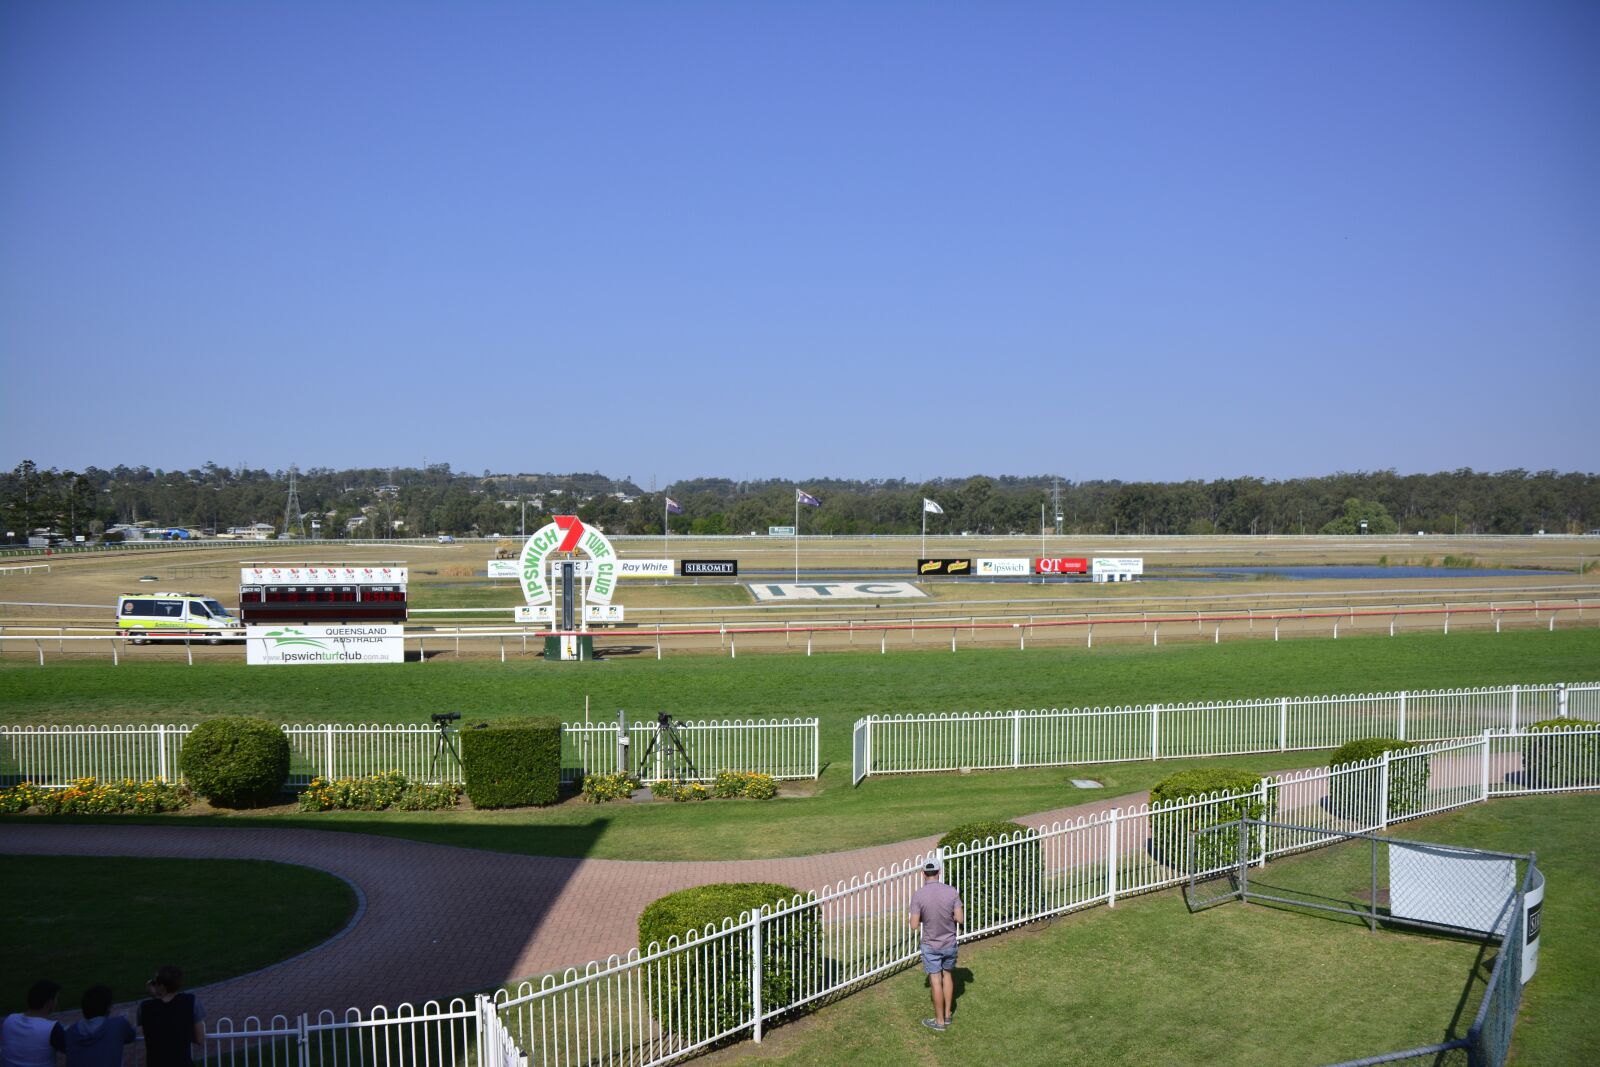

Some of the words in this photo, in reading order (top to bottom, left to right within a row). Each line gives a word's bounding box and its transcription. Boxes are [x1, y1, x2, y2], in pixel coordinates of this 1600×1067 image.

[585, 532, 610, 559] TURF
[524, 528, 558, 598] IPSWICH
[622, 563, 640, 572] Ray
[642, 563, 668, 571] White
[687, 564, 732, 572] SIRROMET
[994, 563, 1024, 573] Ipswich
[1040, 559, 1062, 572] QT
[594, 563, 614, 595] CLUB
[325, 628, 387, 636] QUEENSLAND
